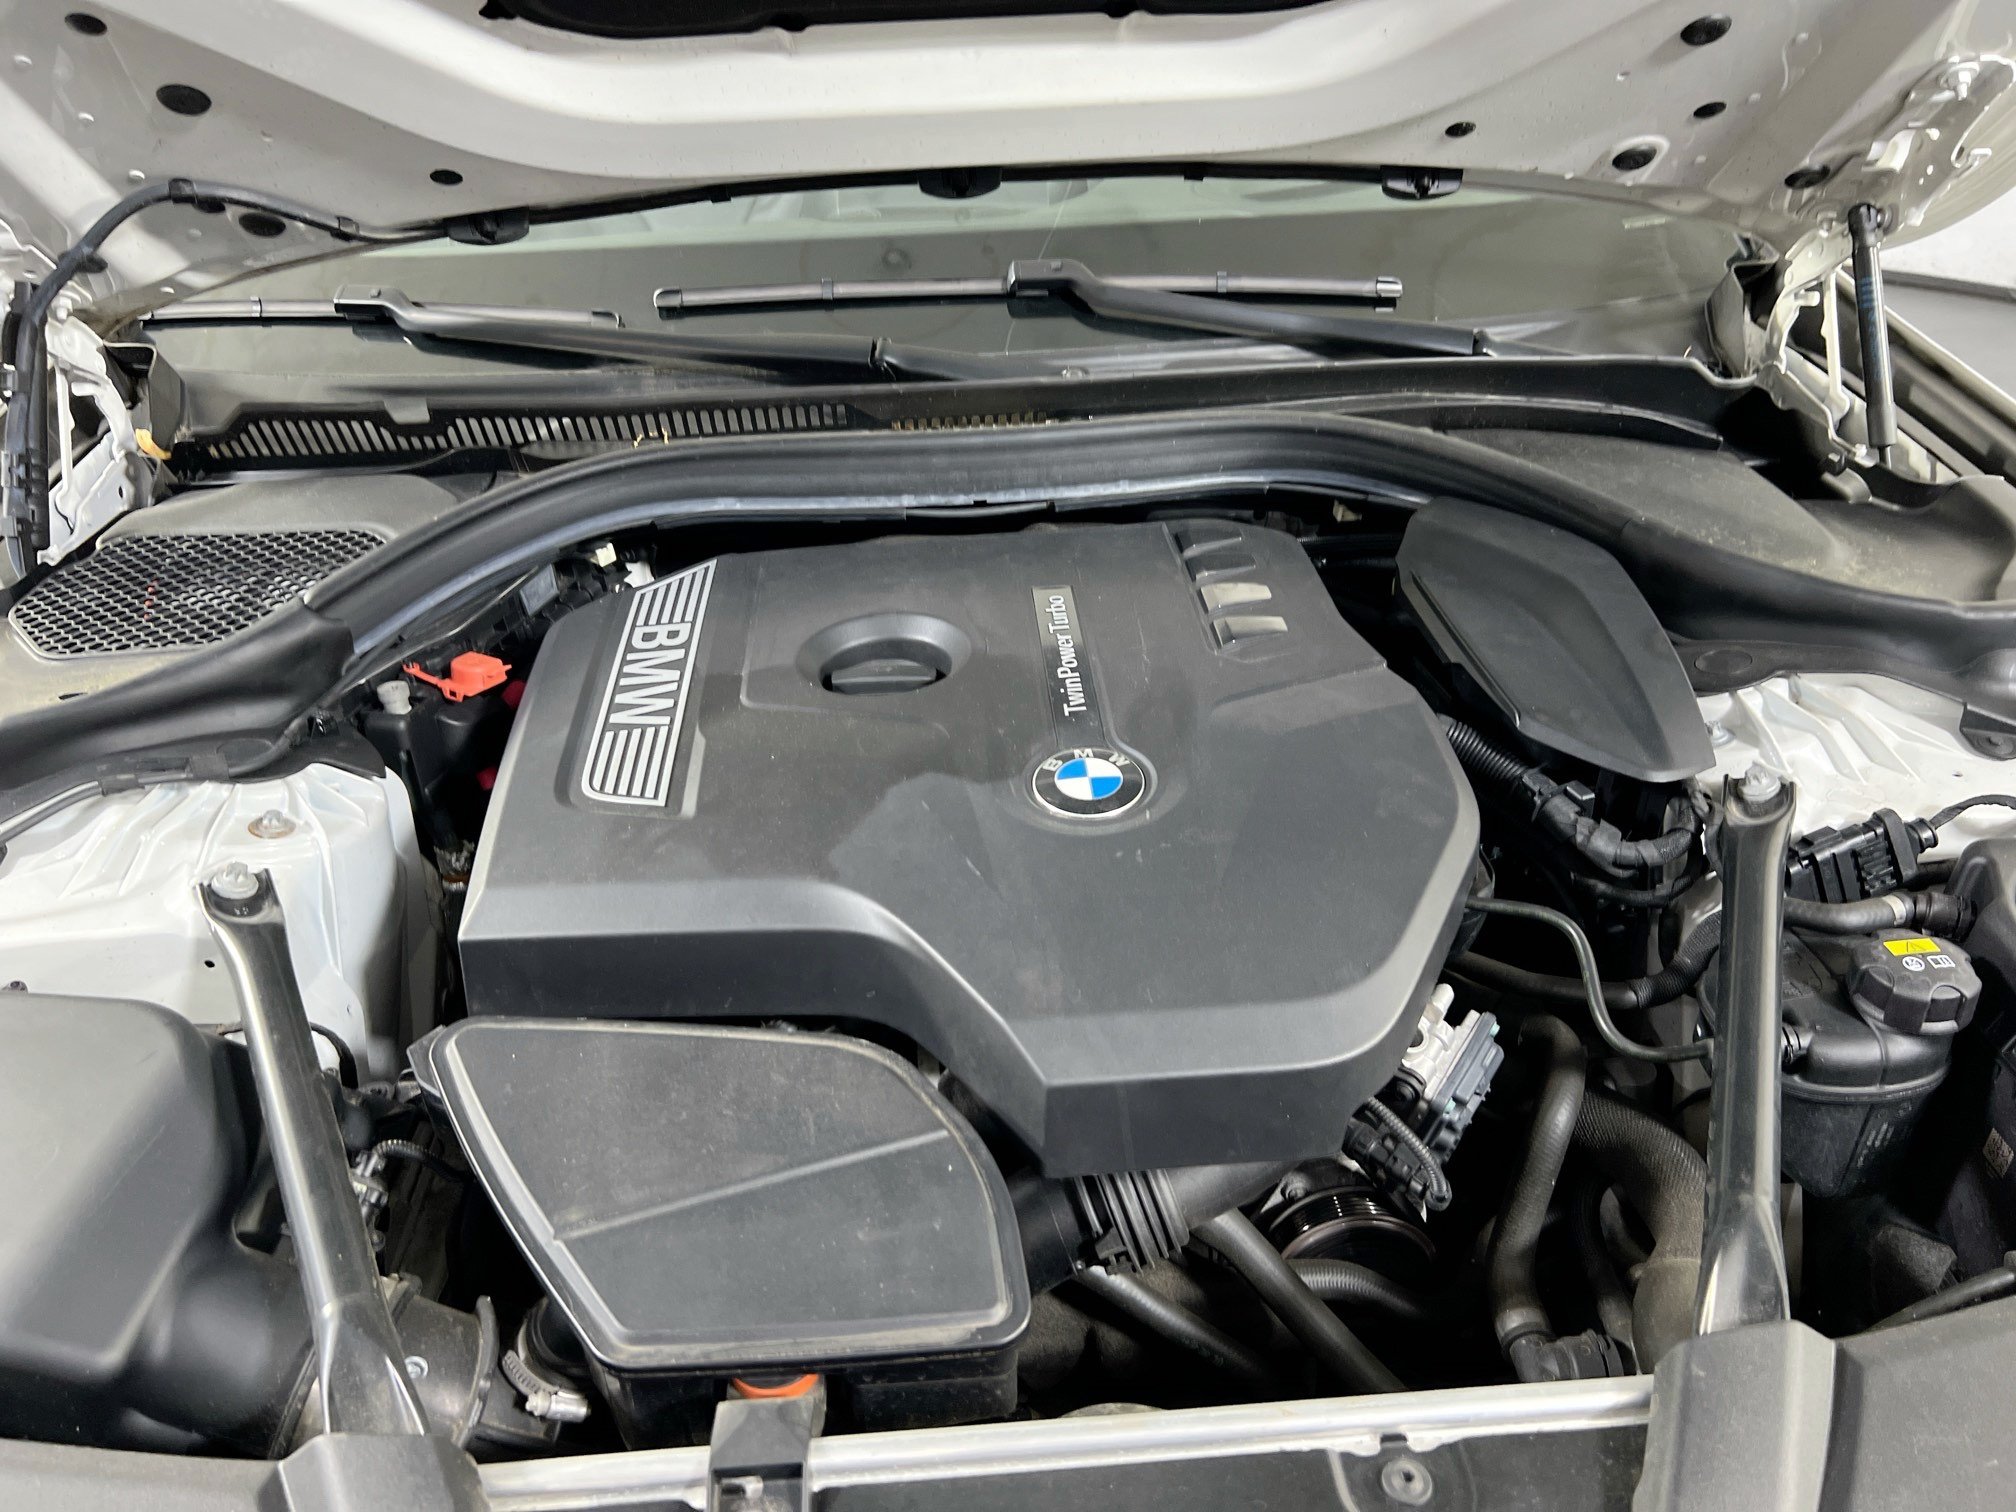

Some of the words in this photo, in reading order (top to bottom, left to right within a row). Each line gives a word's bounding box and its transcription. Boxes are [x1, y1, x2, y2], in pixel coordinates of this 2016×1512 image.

[1045, 595, 1070, 634] Turbo
[610, 622, 691, 725] BMW
[1057, 633, 1088, 717] TwinPower
[1043, 749, 1130, 772] BMW
